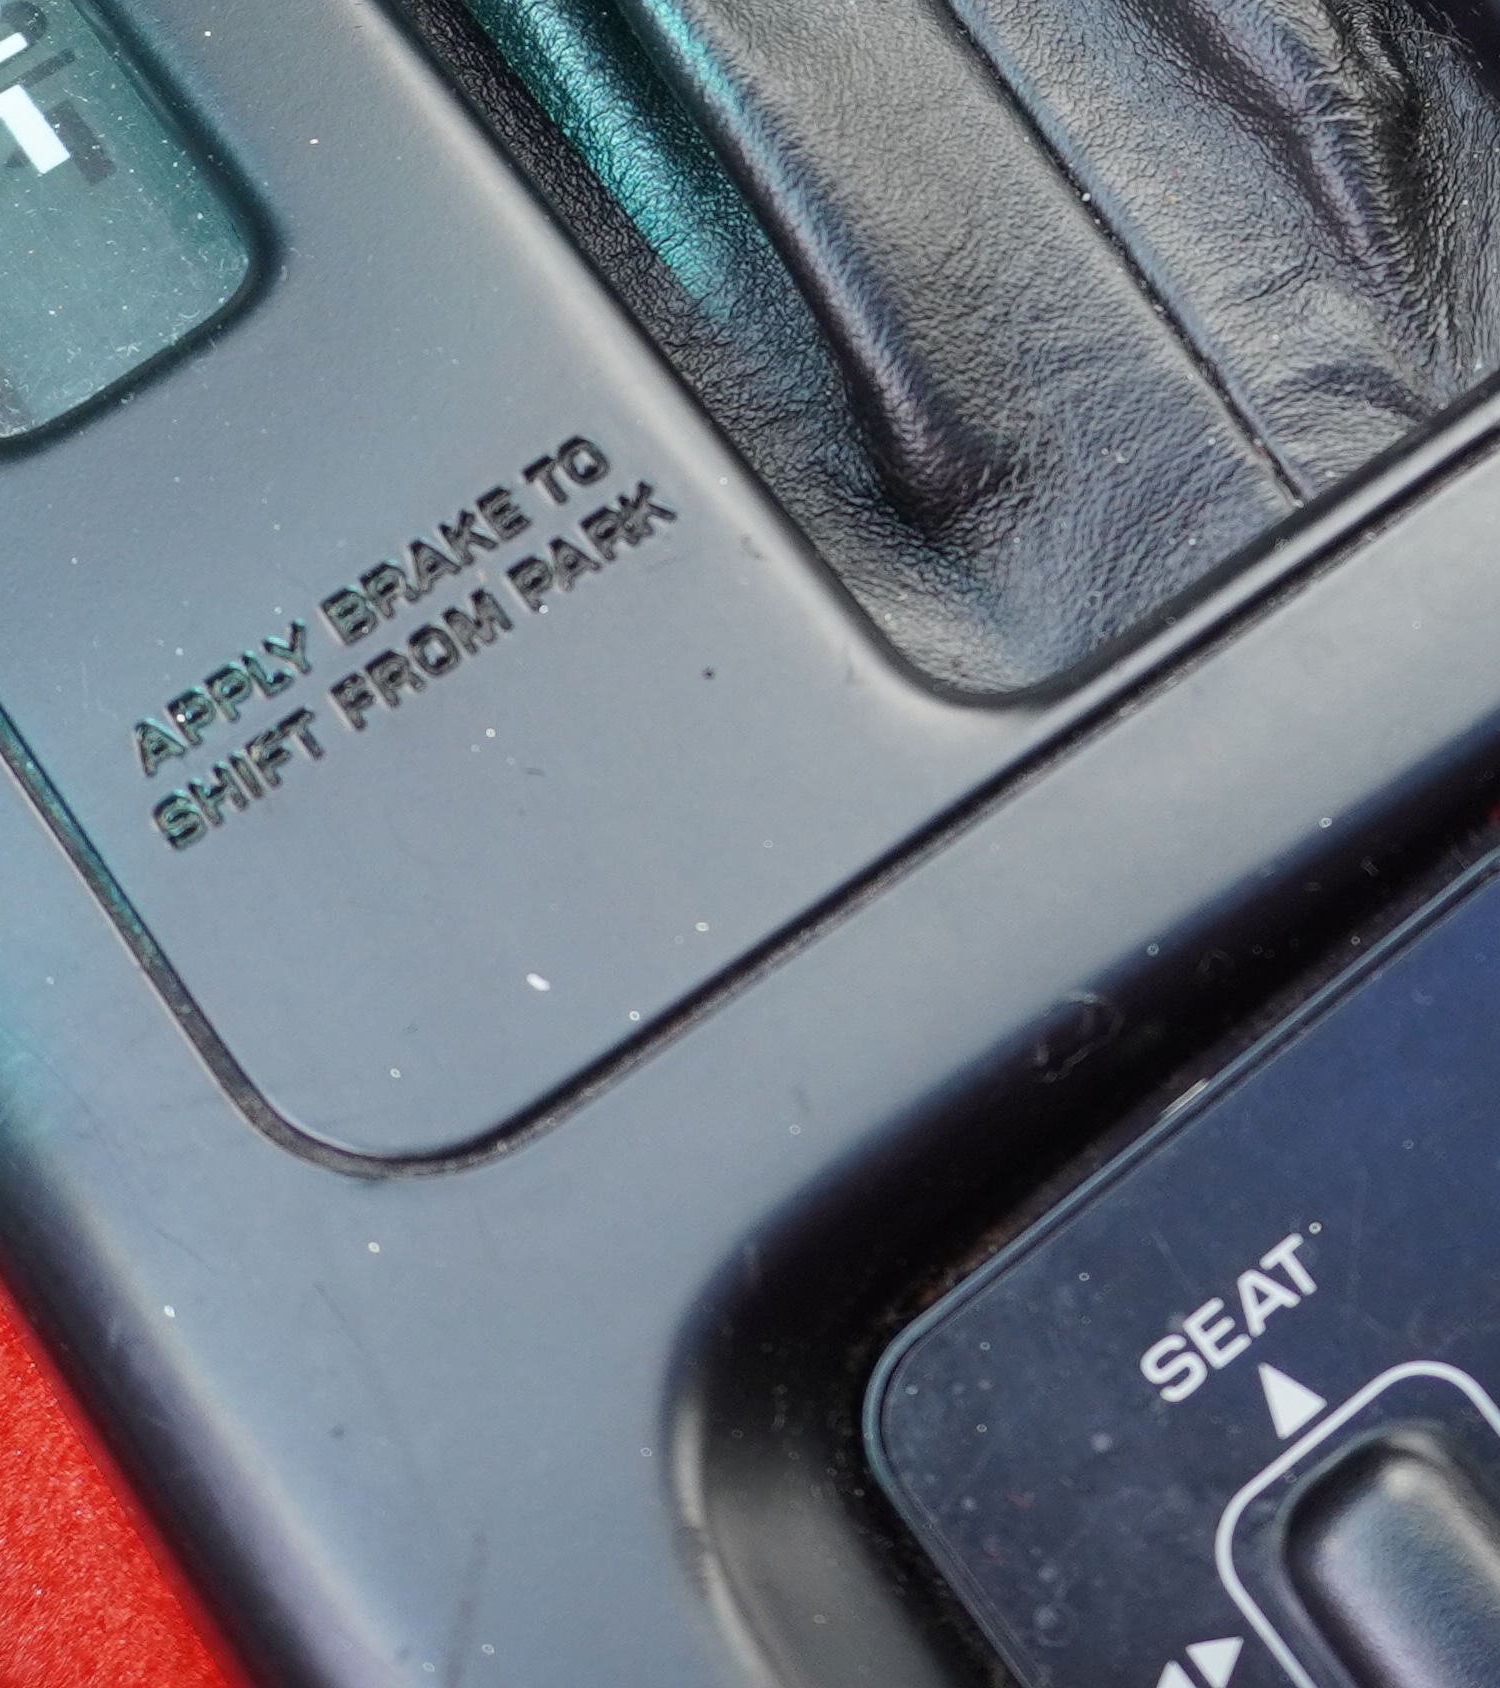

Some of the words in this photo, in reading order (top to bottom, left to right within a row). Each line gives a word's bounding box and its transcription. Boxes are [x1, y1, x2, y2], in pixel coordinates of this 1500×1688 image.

[132, 618, 314, 779] APPLY
[318, 485, 533, 647] BRAKE
[522, 434, 612, 506] TO
[151, 707, 325, 852] SHIFT
[329, 587, 515, 732] FROM
[505, 480, 679, 612] PARK
[1139, 1233, 1321, 1404] SEAT
